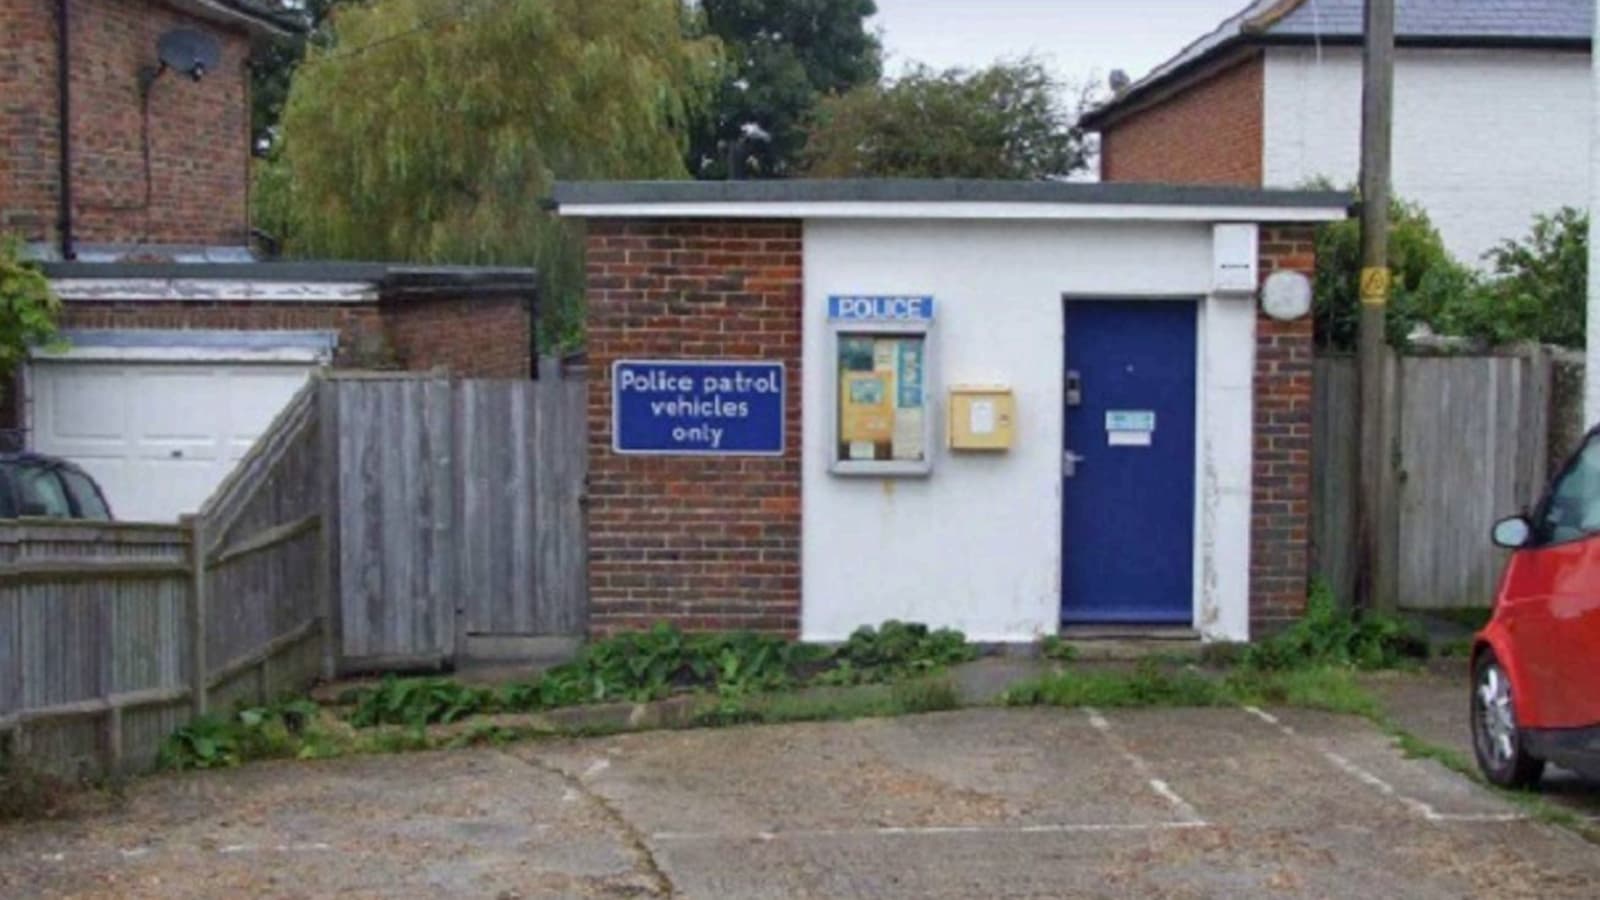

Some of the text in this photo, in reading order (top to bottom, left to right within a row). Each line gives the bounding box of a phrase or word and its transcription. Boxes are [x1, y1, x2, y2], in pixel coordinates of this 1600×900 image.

[839, 298, 921, 319] POLICE
[621, 369, 780, 394] Police patrol
[651, 394, 749, 417] vehicles
[672, 423, 724, 449] only
